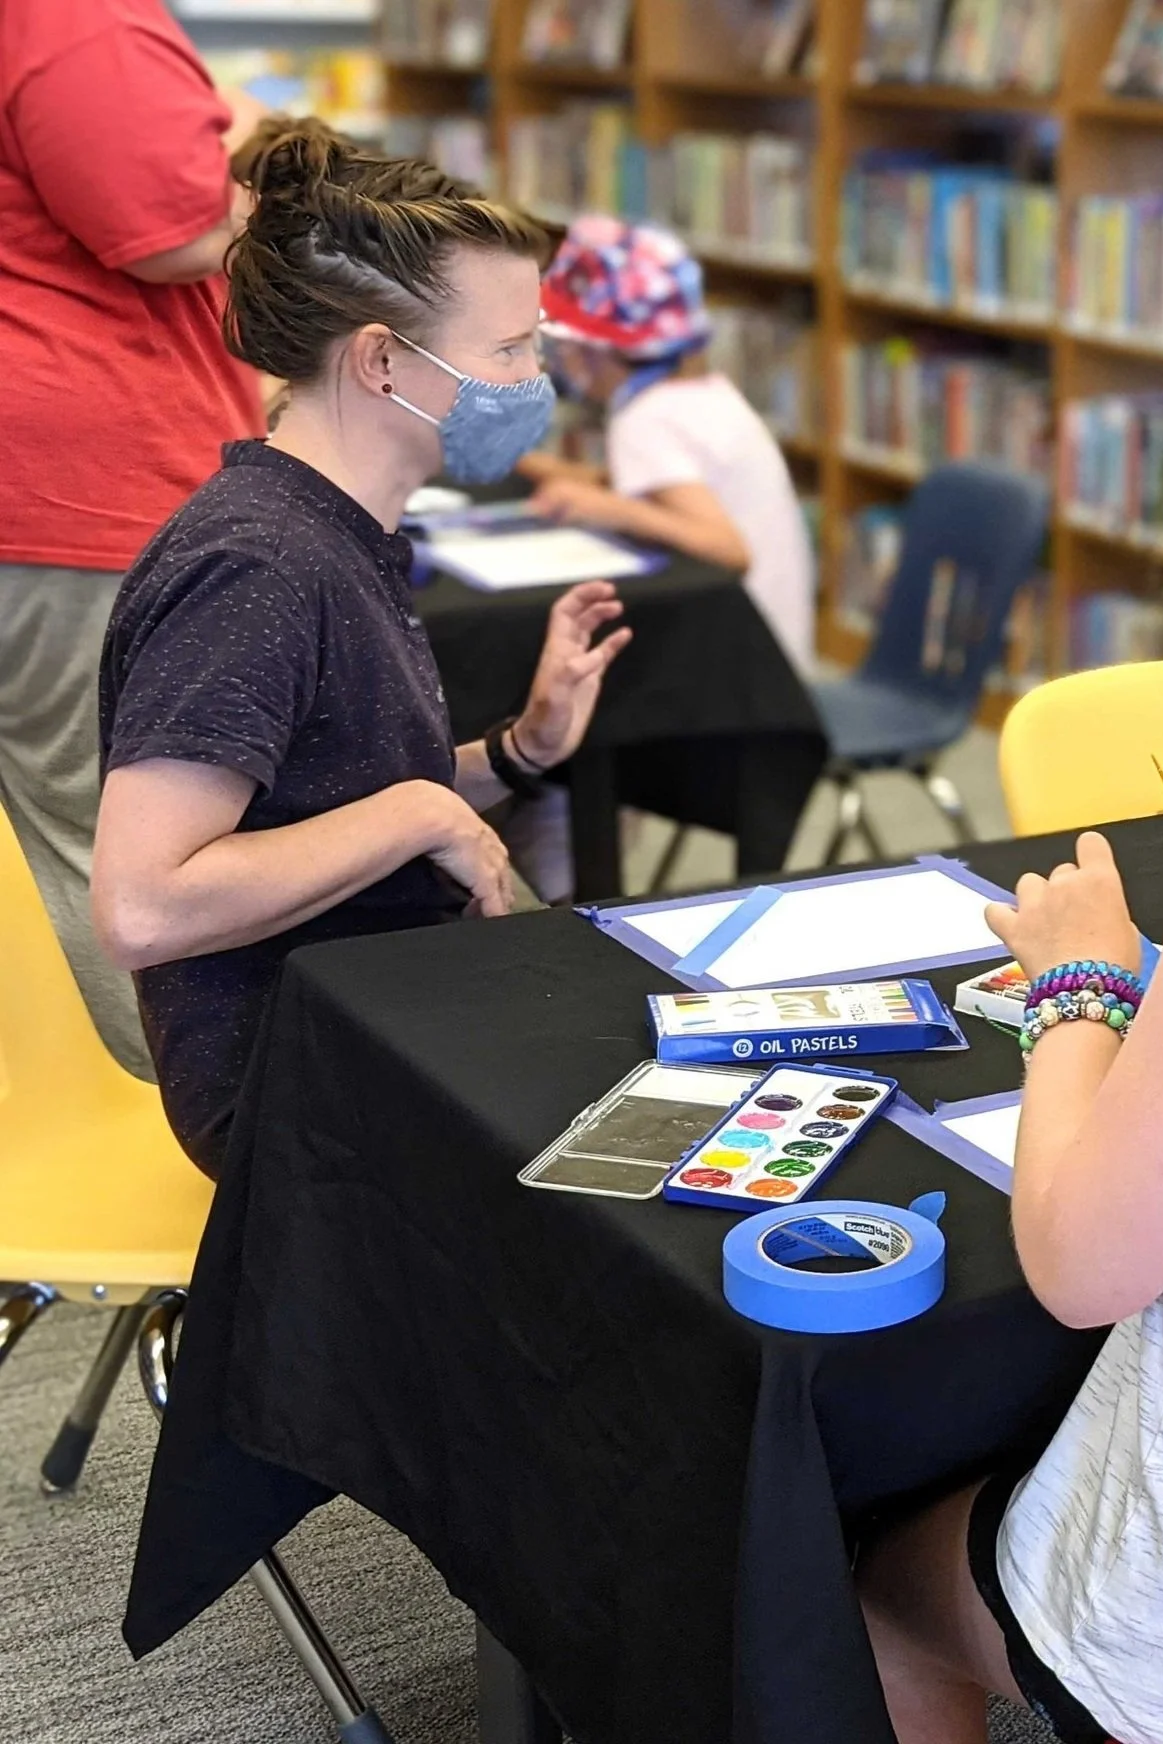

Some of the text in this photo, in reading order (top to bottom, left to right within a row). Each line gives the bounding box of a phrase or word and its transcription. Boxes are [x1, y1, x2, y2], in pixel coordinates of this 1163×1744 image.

[760, 1040, 785, 1054] OIL
[791, 1035, 858, 1053] PASTELS
[845, 1223, 874, 1234] Scotch
